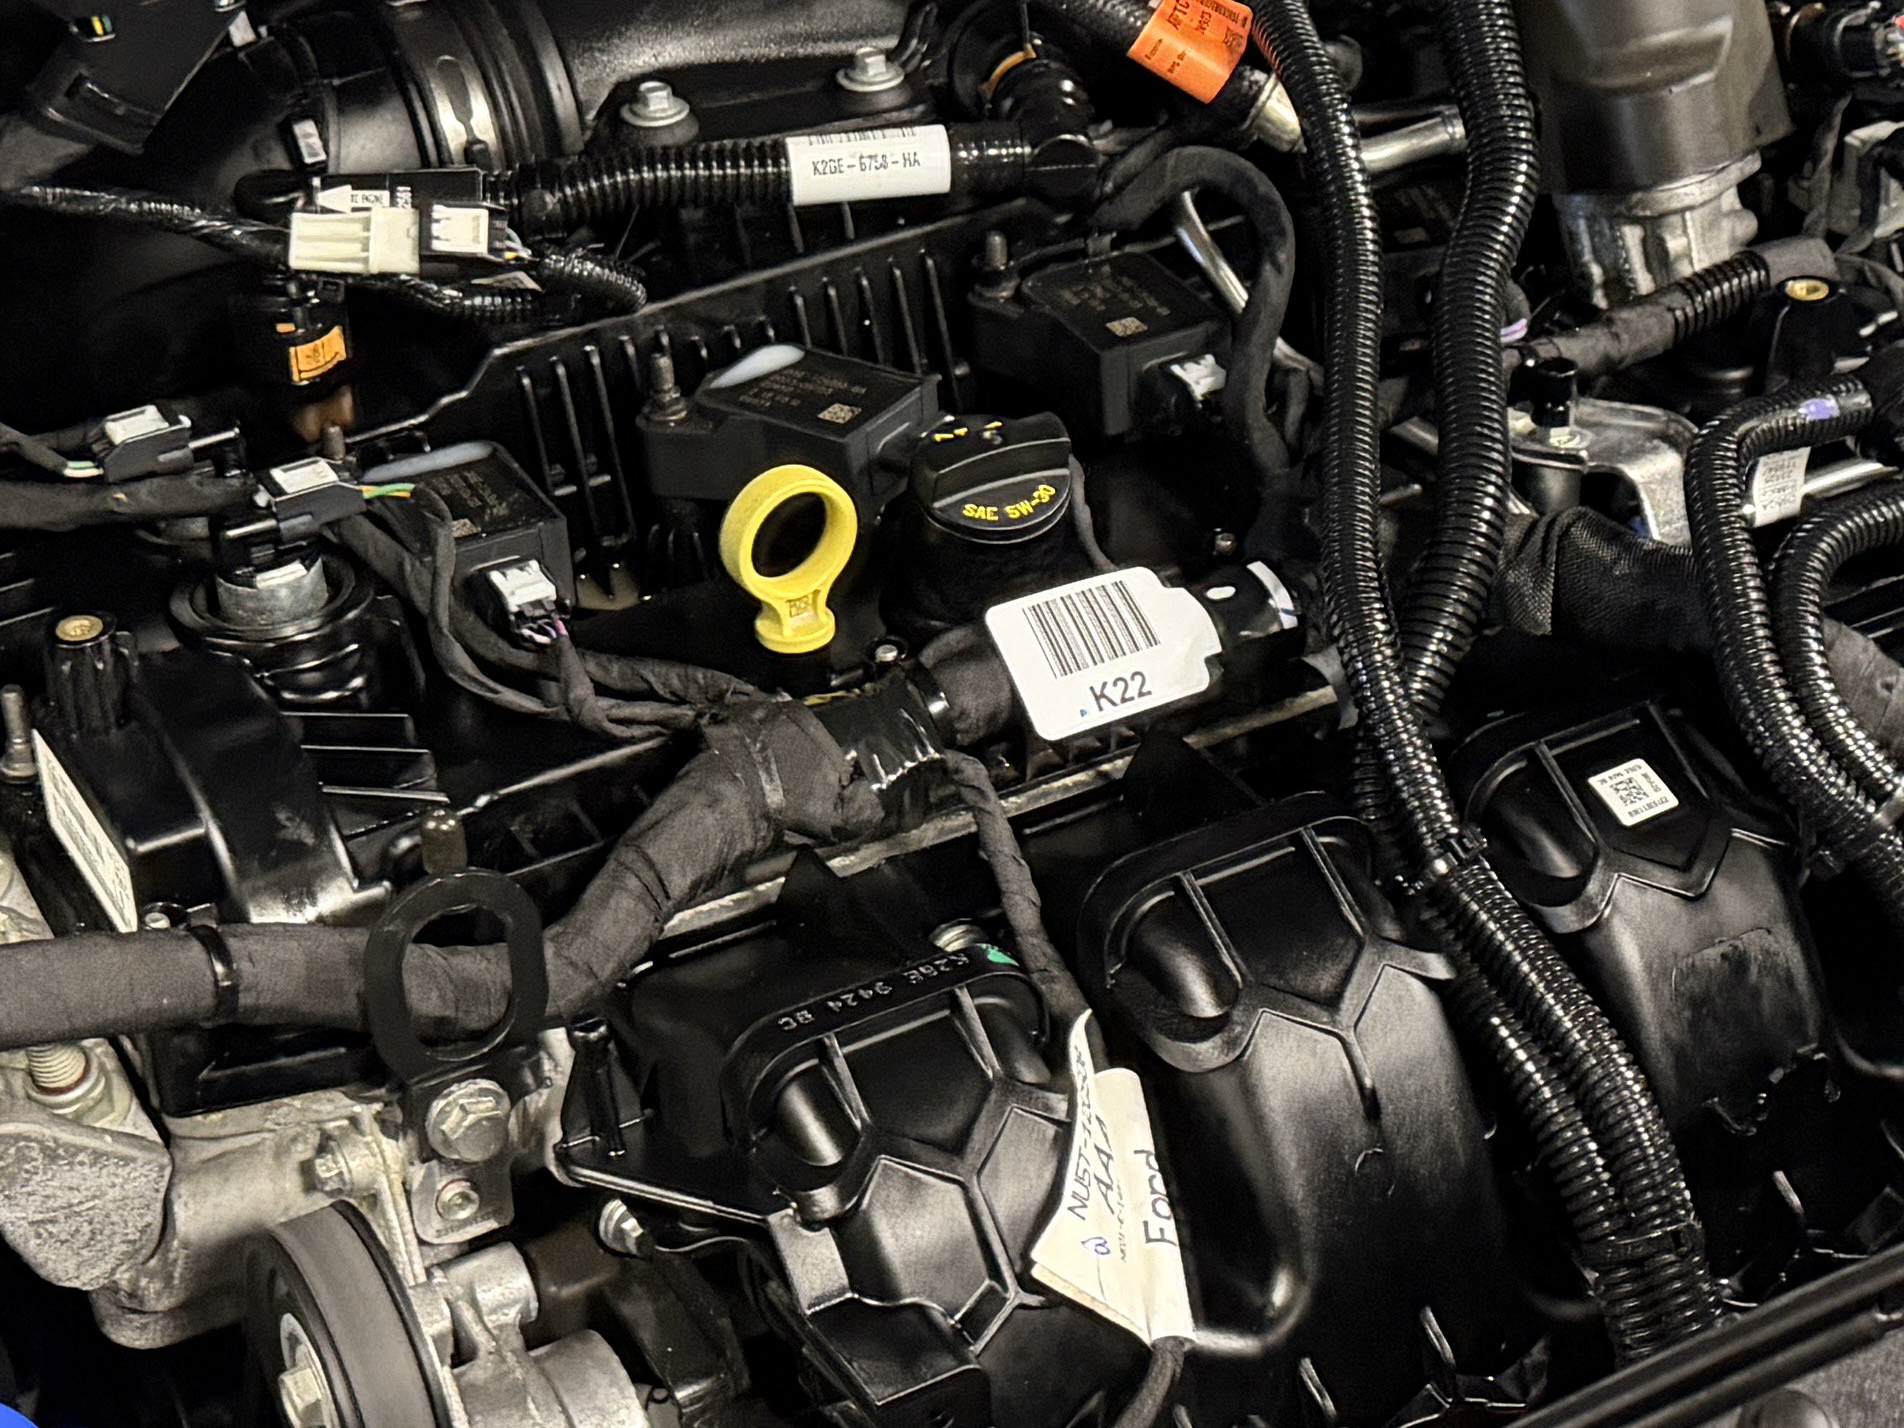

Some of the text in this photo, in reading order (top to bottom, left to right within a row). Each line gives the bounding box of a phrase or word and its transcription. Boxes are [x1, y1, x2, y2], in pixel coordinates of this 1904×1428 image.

[962, 484, 1056, 521] SAE 5W-30
[1088, 671, 1154, 713] K22
